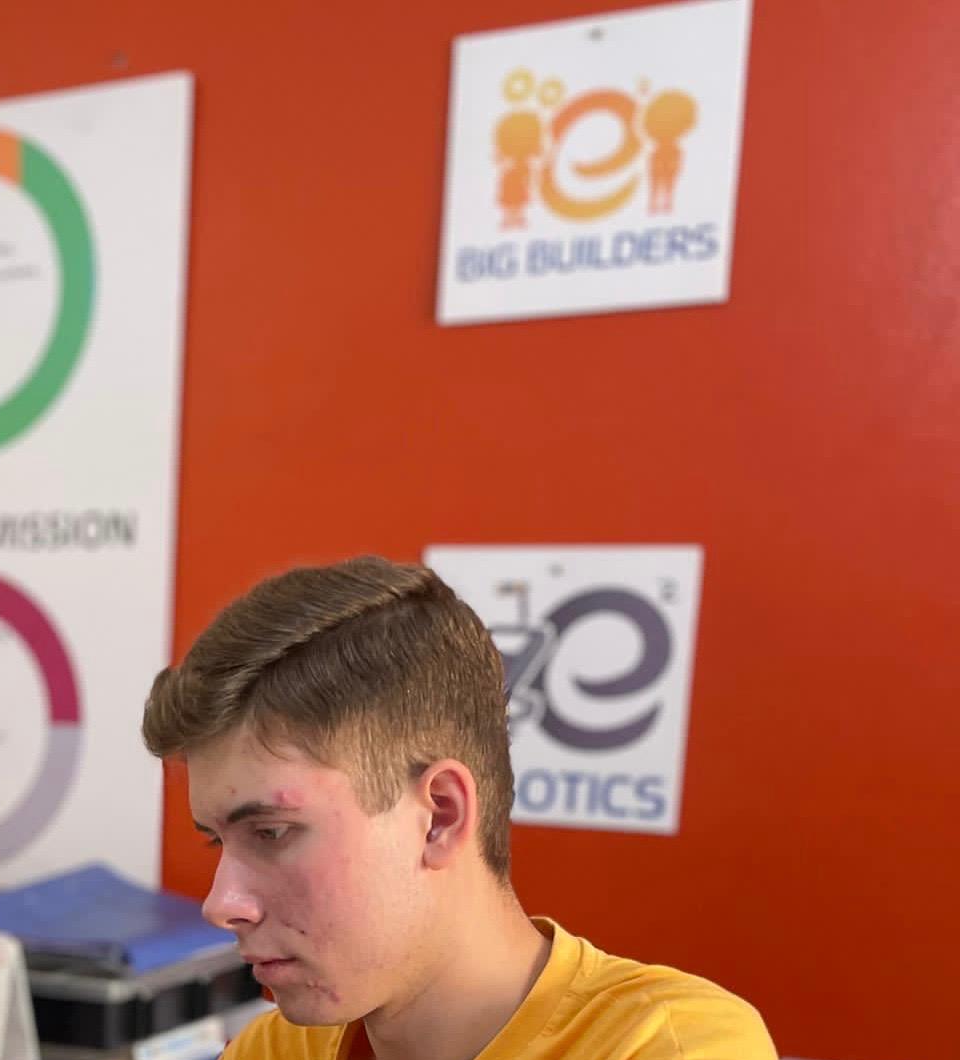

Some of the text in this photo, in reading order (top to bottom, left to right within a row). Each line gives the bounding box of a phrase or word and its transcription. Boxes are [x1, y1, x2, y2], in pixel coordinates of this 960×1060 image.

[455, 223, 718, 282] BIG BUILDERS
[517, 767, 666, 820] OTICS
